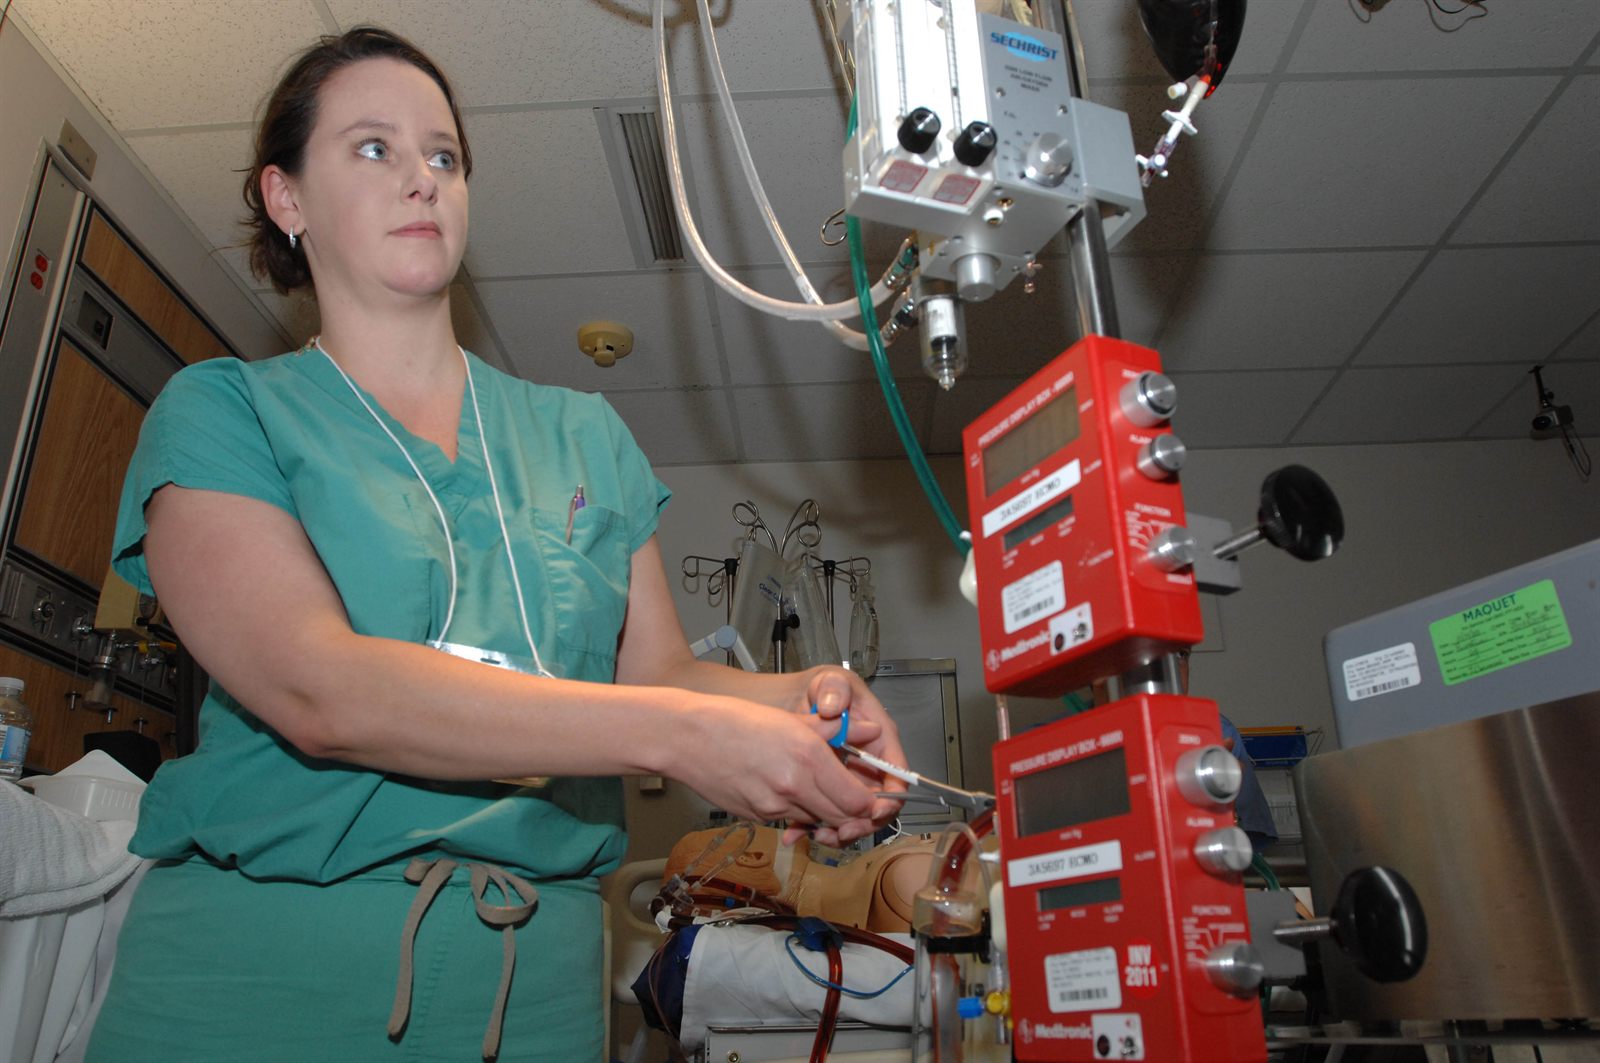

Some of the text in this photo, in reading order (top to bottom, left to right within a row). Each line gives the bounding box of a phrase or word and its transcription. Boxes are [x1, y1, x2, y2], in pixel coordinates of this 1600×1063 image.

[991, 32, 1058, 60] SECHRIST
[1462, 593, 1516, 622] MAQUET
[1068, 852, 1098, 869] ECMO
[1127, 945, 1151, 966] INV
[1125, 966, 1158, 987] 2011
[1034, 1022, 1092, 1039] Medtronic
